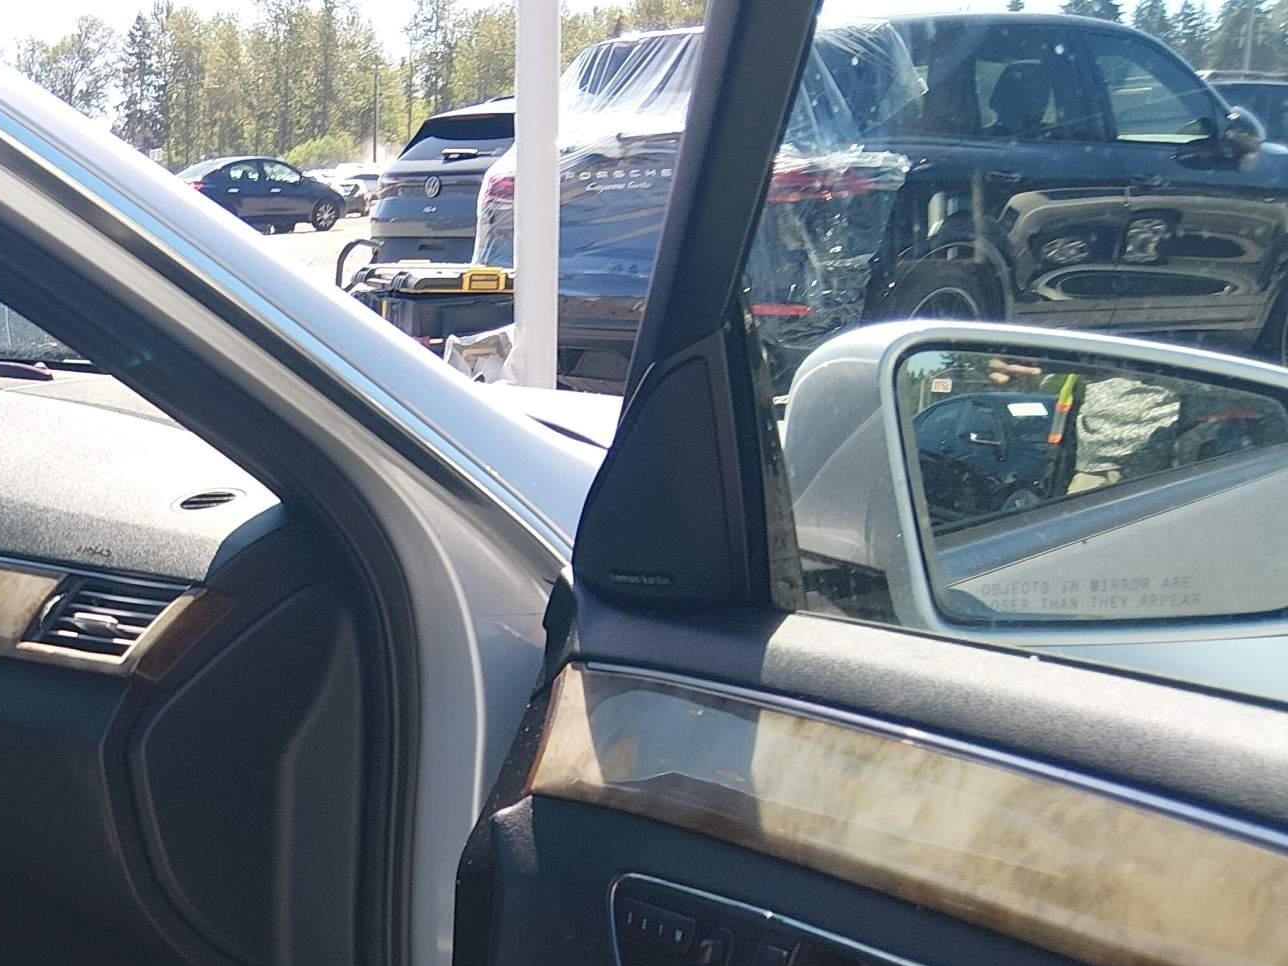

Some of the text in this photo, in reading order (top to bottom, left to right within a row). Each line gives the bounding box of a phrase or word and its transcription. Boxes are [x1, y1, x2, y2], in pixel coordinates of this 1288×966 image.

[562, 168, 673, 181] PORSCHE
[982, 575, 1192, 596] OBJECTS IN MIRROR ARE
[990, 592, 1201, 609] OSER THAN THEY APPEAR
